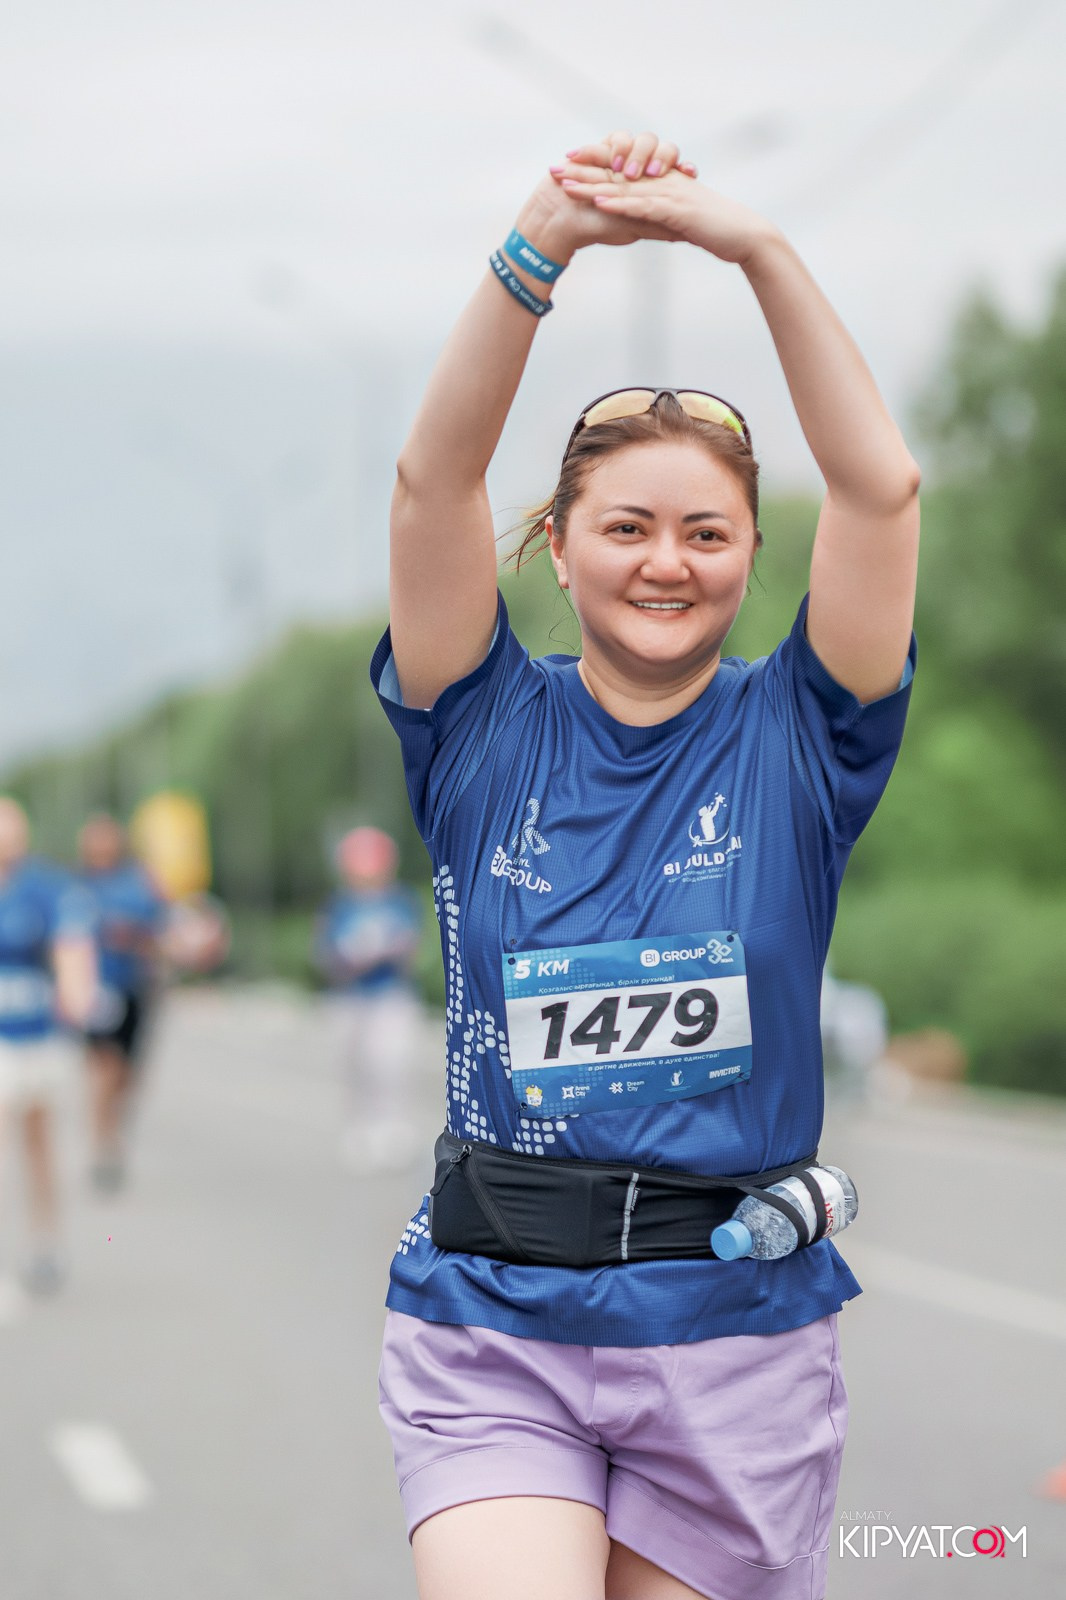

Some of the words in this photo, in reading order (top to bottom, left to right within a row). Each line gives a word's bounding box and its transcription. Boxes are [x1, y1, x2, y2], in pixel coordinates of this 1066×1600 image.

[519, 246, 543, 267] RUN
[508, 276, 520, 293] City
[502, 858, 552, 894] GROUP
[663, 862, 680, 876] BI
[661, 947, 707, 962] GROUP
[513, 959, 531, 980] 5
[537, 959, 570, 977] KM
[618, 978, 640, 987] бірлік
[541, 988, 719, 1060] 1479
[594, 1063, 617, 1072] ритме
[664, 1056, 682, 1065] духе
[709, 1065, 742, 1079] INVICTUS
